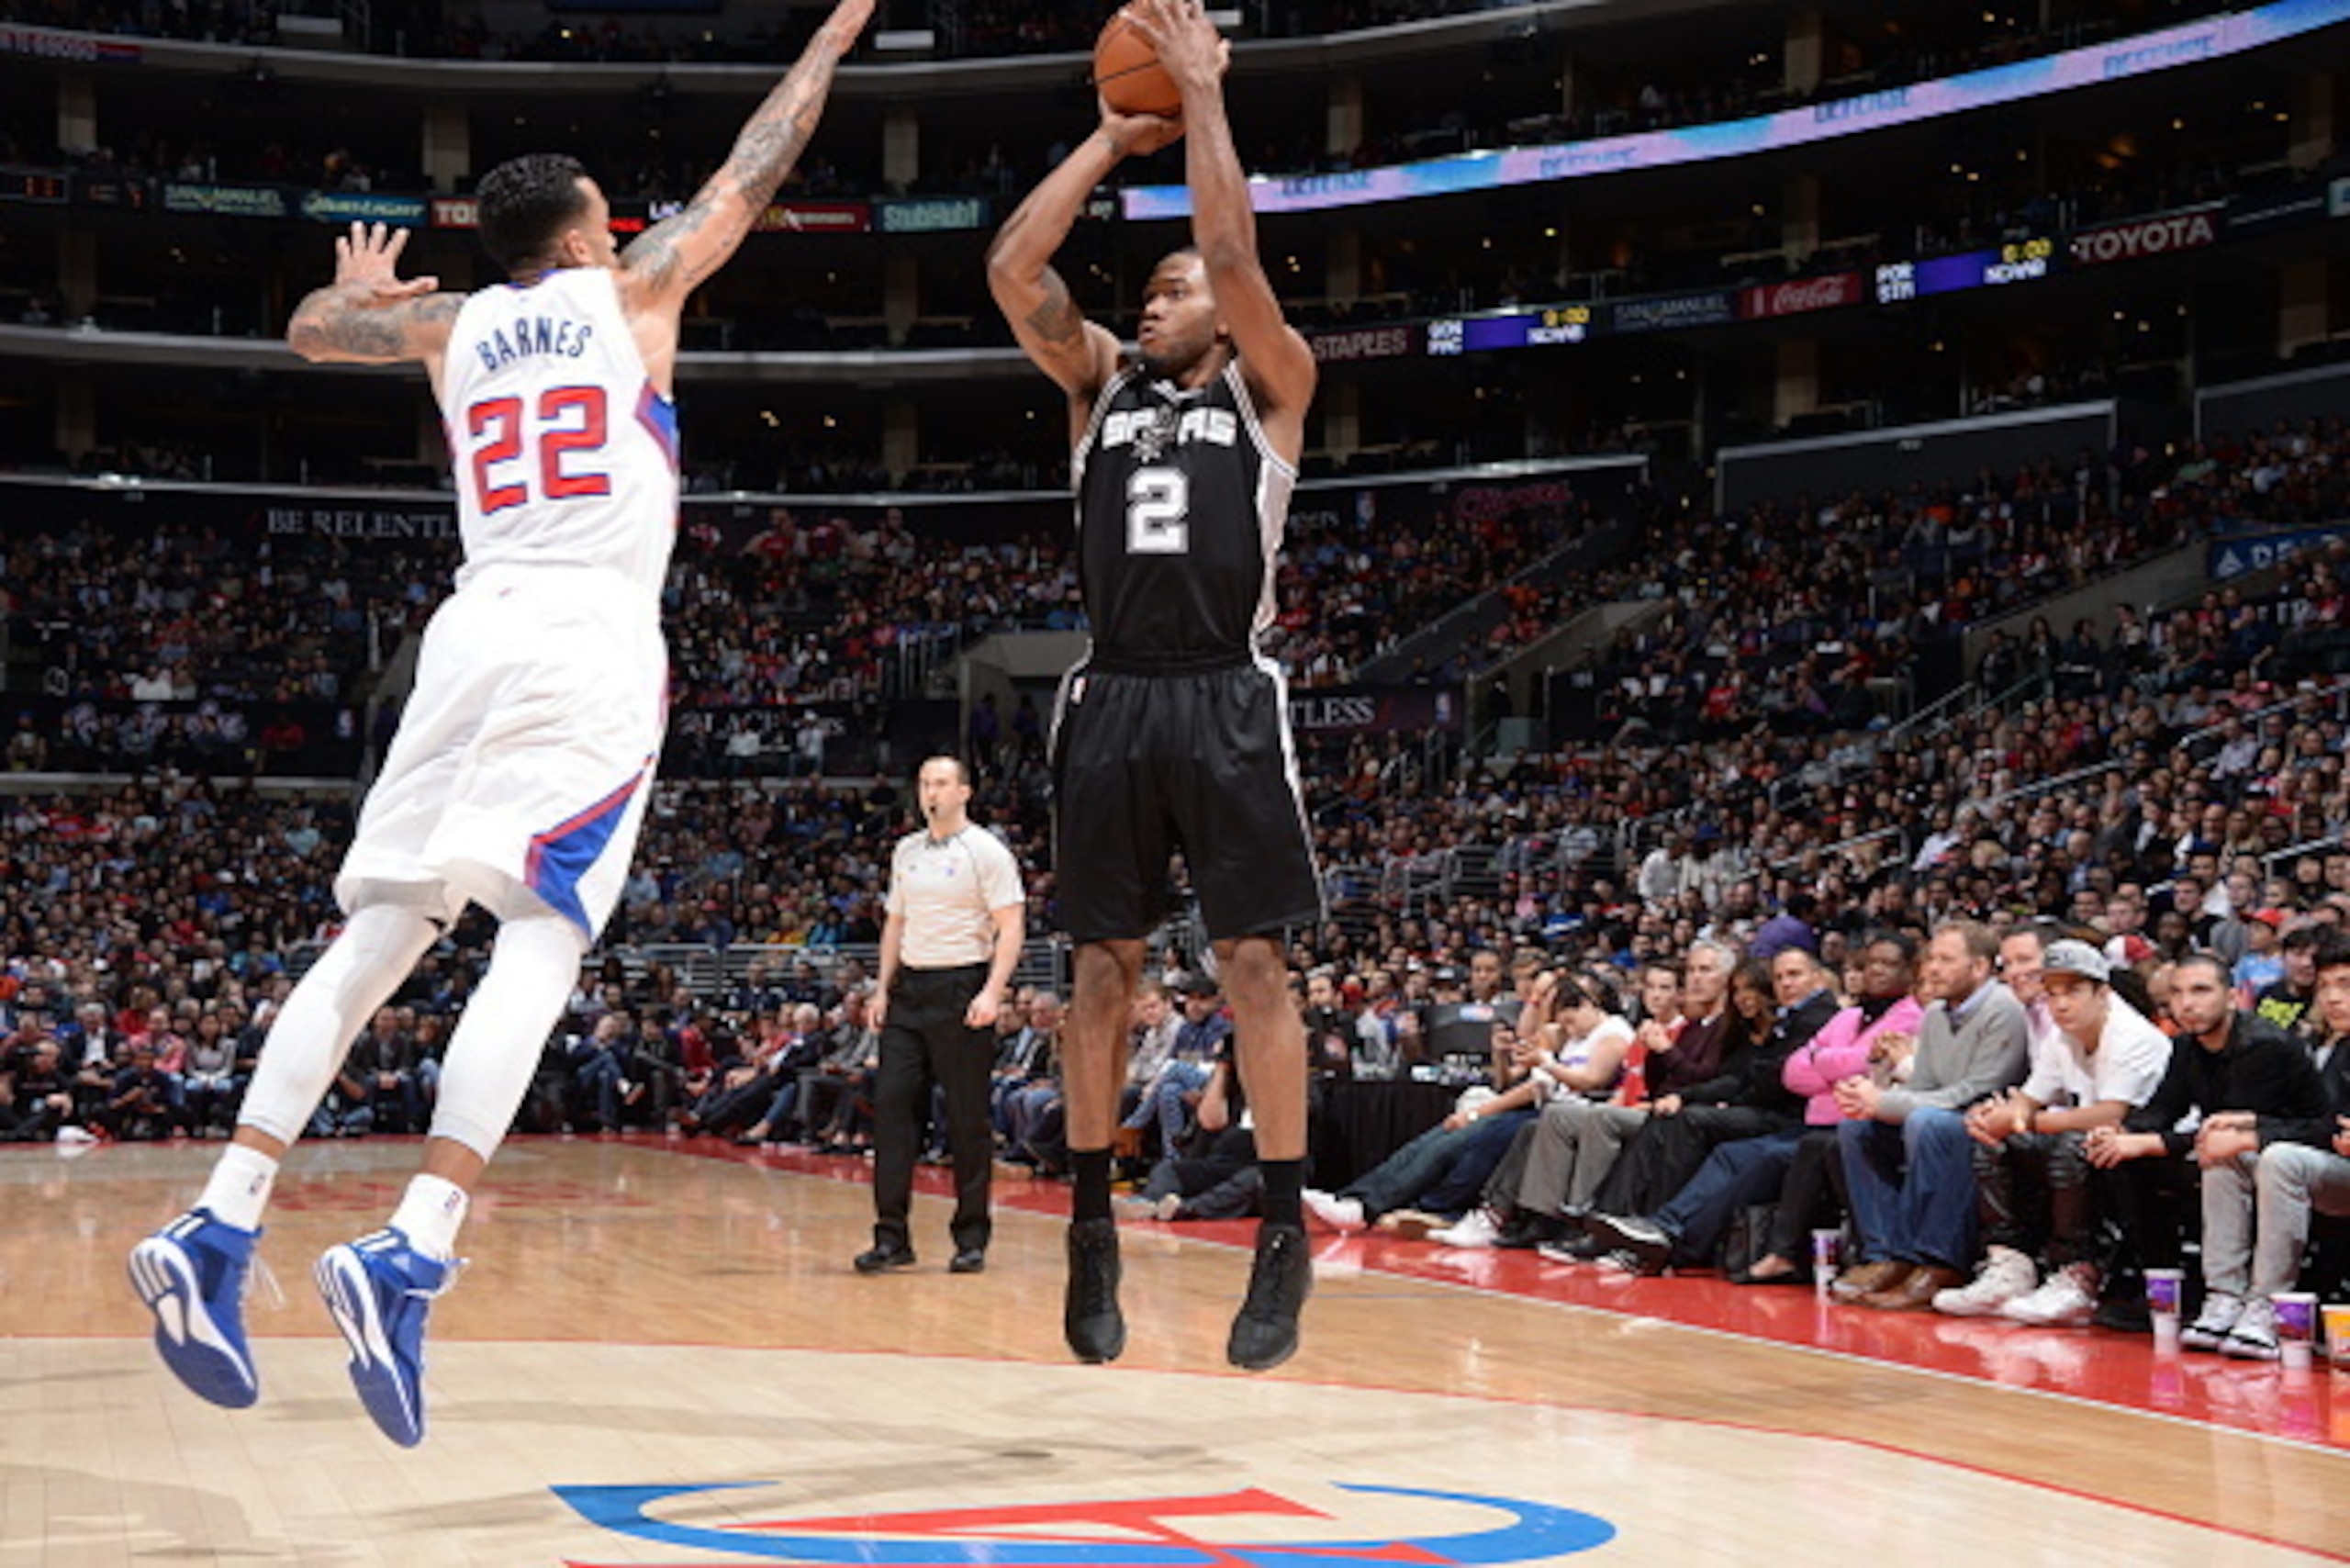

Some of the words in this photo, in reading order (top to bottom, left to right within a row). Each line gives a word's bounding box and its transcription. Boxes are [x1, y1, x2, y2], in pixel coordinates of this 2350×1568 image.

[2074, 214, 2214, 263] TOYOTA
[476, 317, 592, 371] BARNES
[1313, 327, 1408, 363] STAPLES
[468, 385, 611, 517] 22
[266, 507, 305, 534] BE
[1125, 465, 1190, 554] 2
